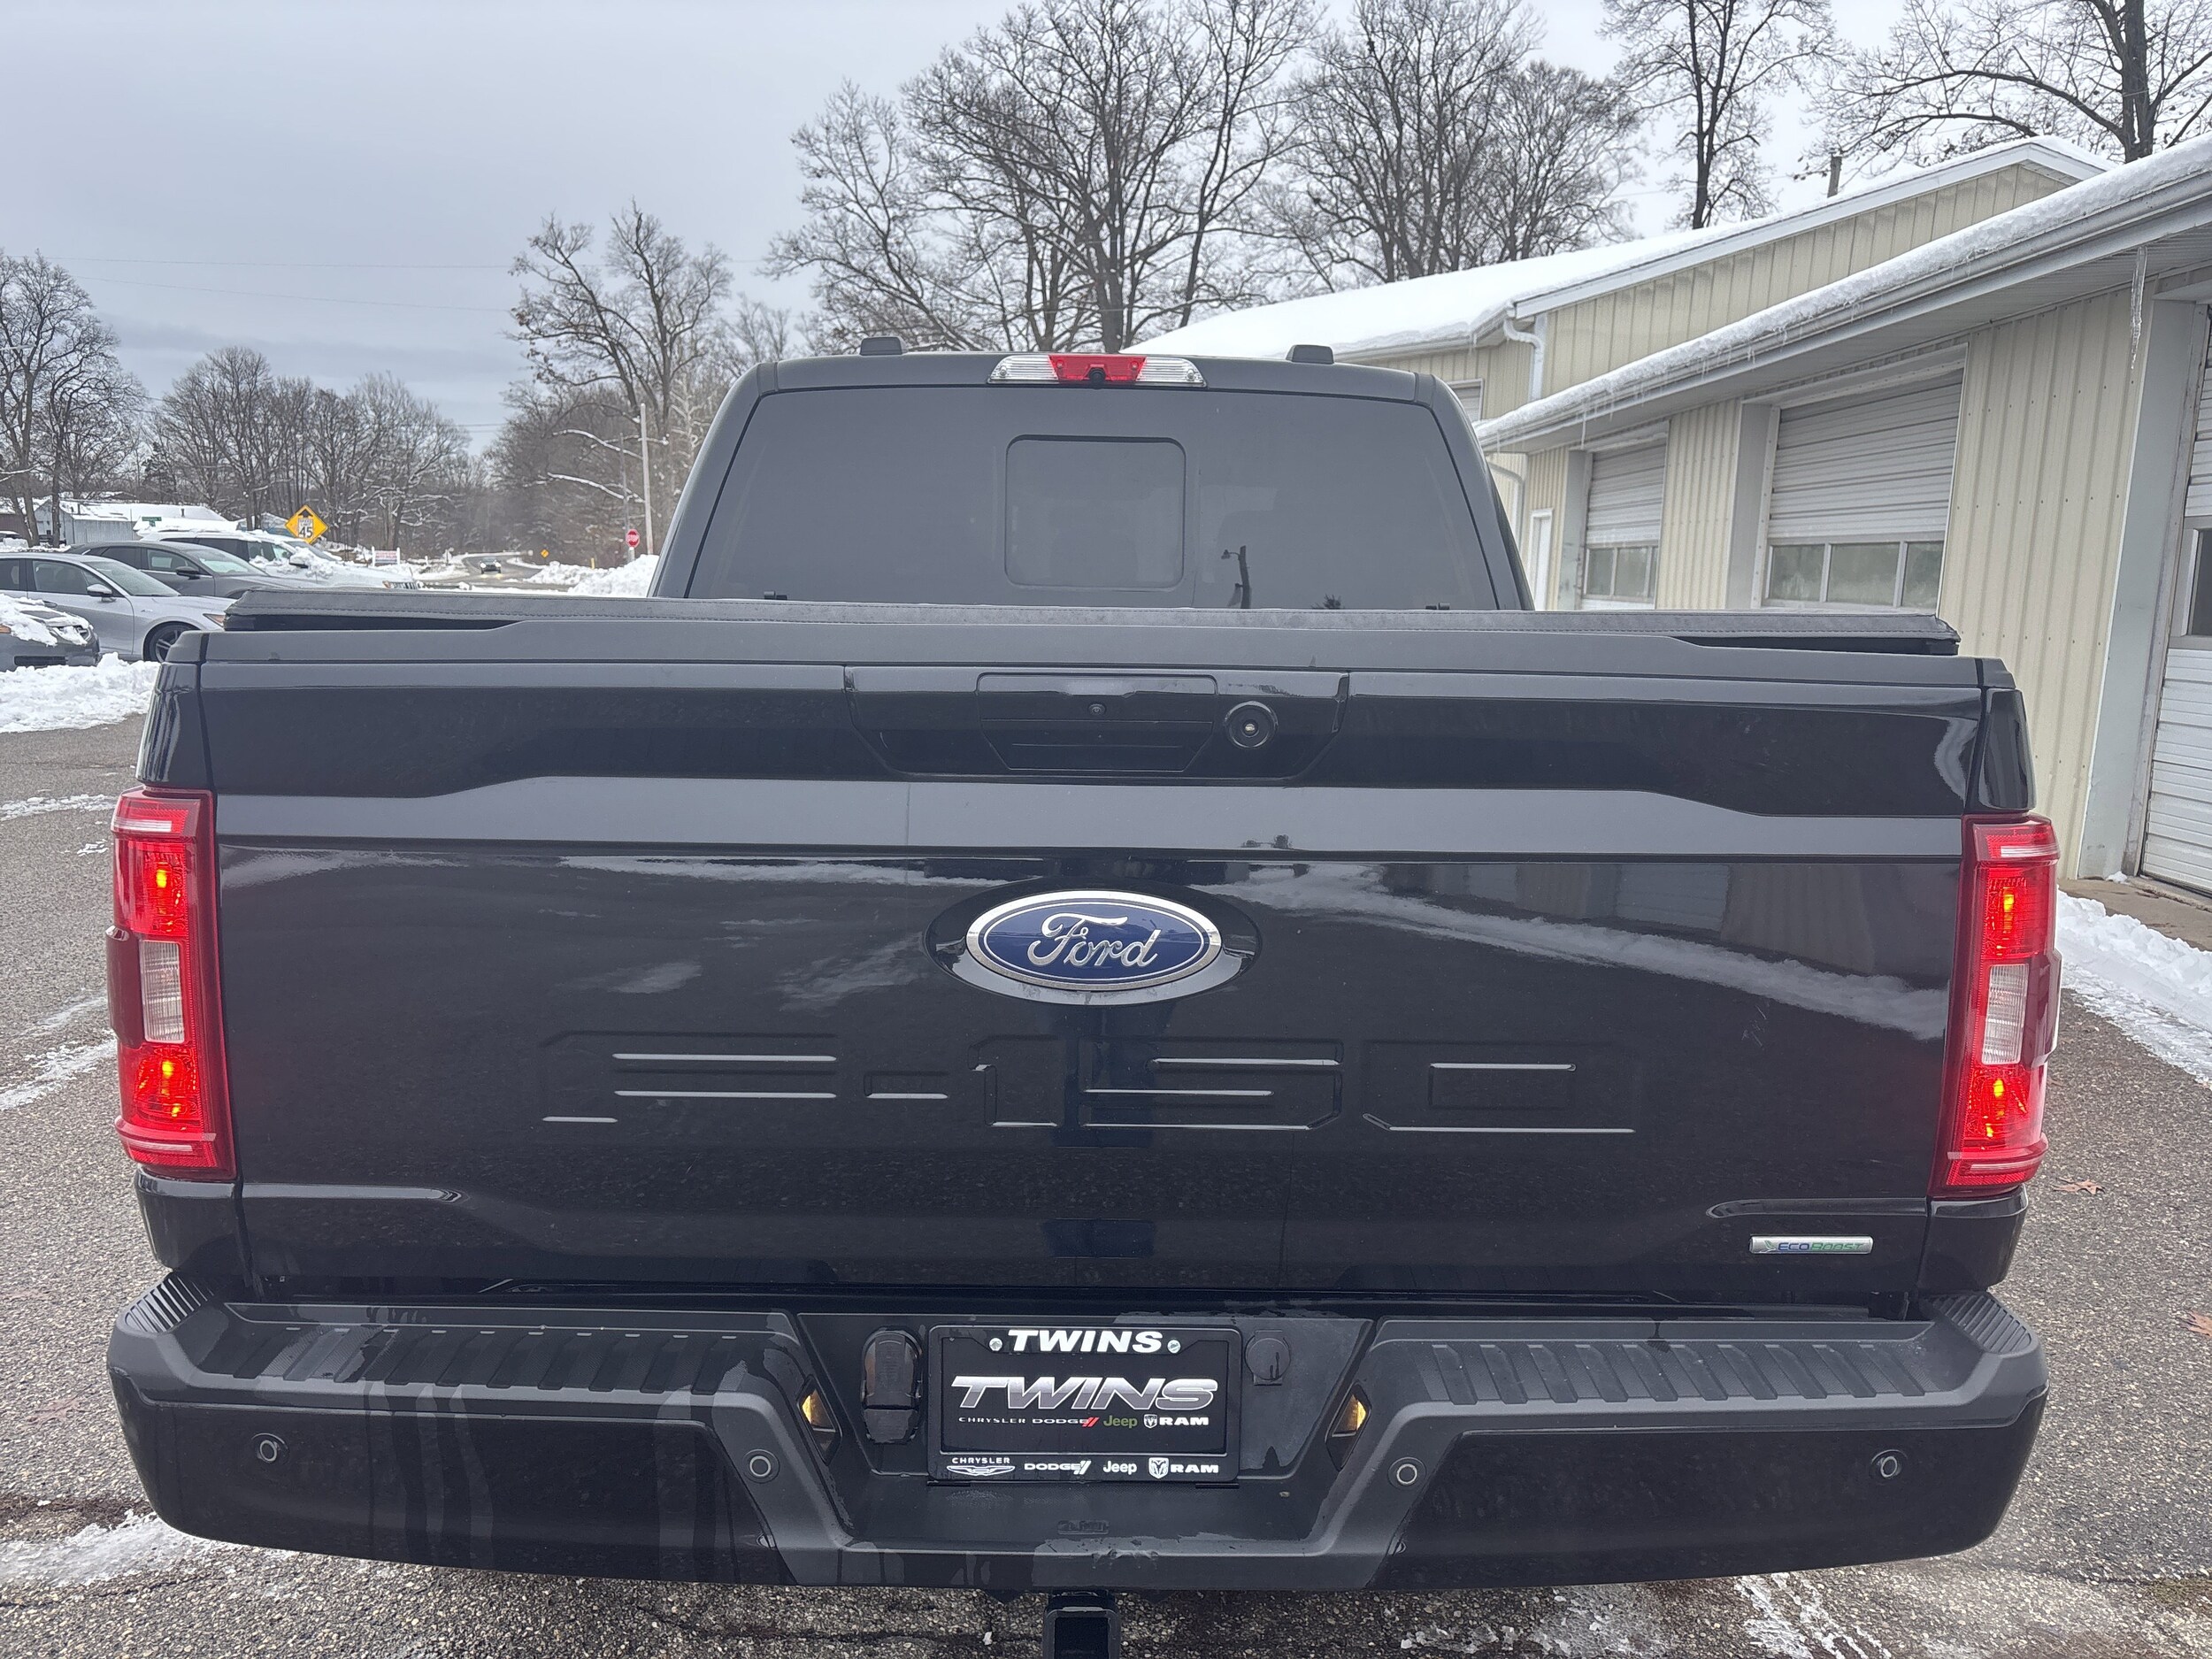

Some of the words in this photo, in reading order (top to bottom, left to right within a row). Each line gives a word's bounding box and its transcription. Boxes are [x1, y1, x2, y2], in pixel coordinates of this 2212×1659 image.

[299, 526, 313, 538] 45
[1027, 912, 1161, 967] Ford
[537, 1028, 1642, 1136] F-150
[1008, 1329, 1163, 1353] TWINS
[950, 1375, 1218, 1411] TWINS
[1102, 1415, 1138, 1429] Jeep
[1159, 1417, 1210, 1425] RAM
[1024, 1463, 1083, 1471] DODGE
[1102, 1460, 1138, 1475] Jeep
[1170, 1463, 1219, 1473] RAM
